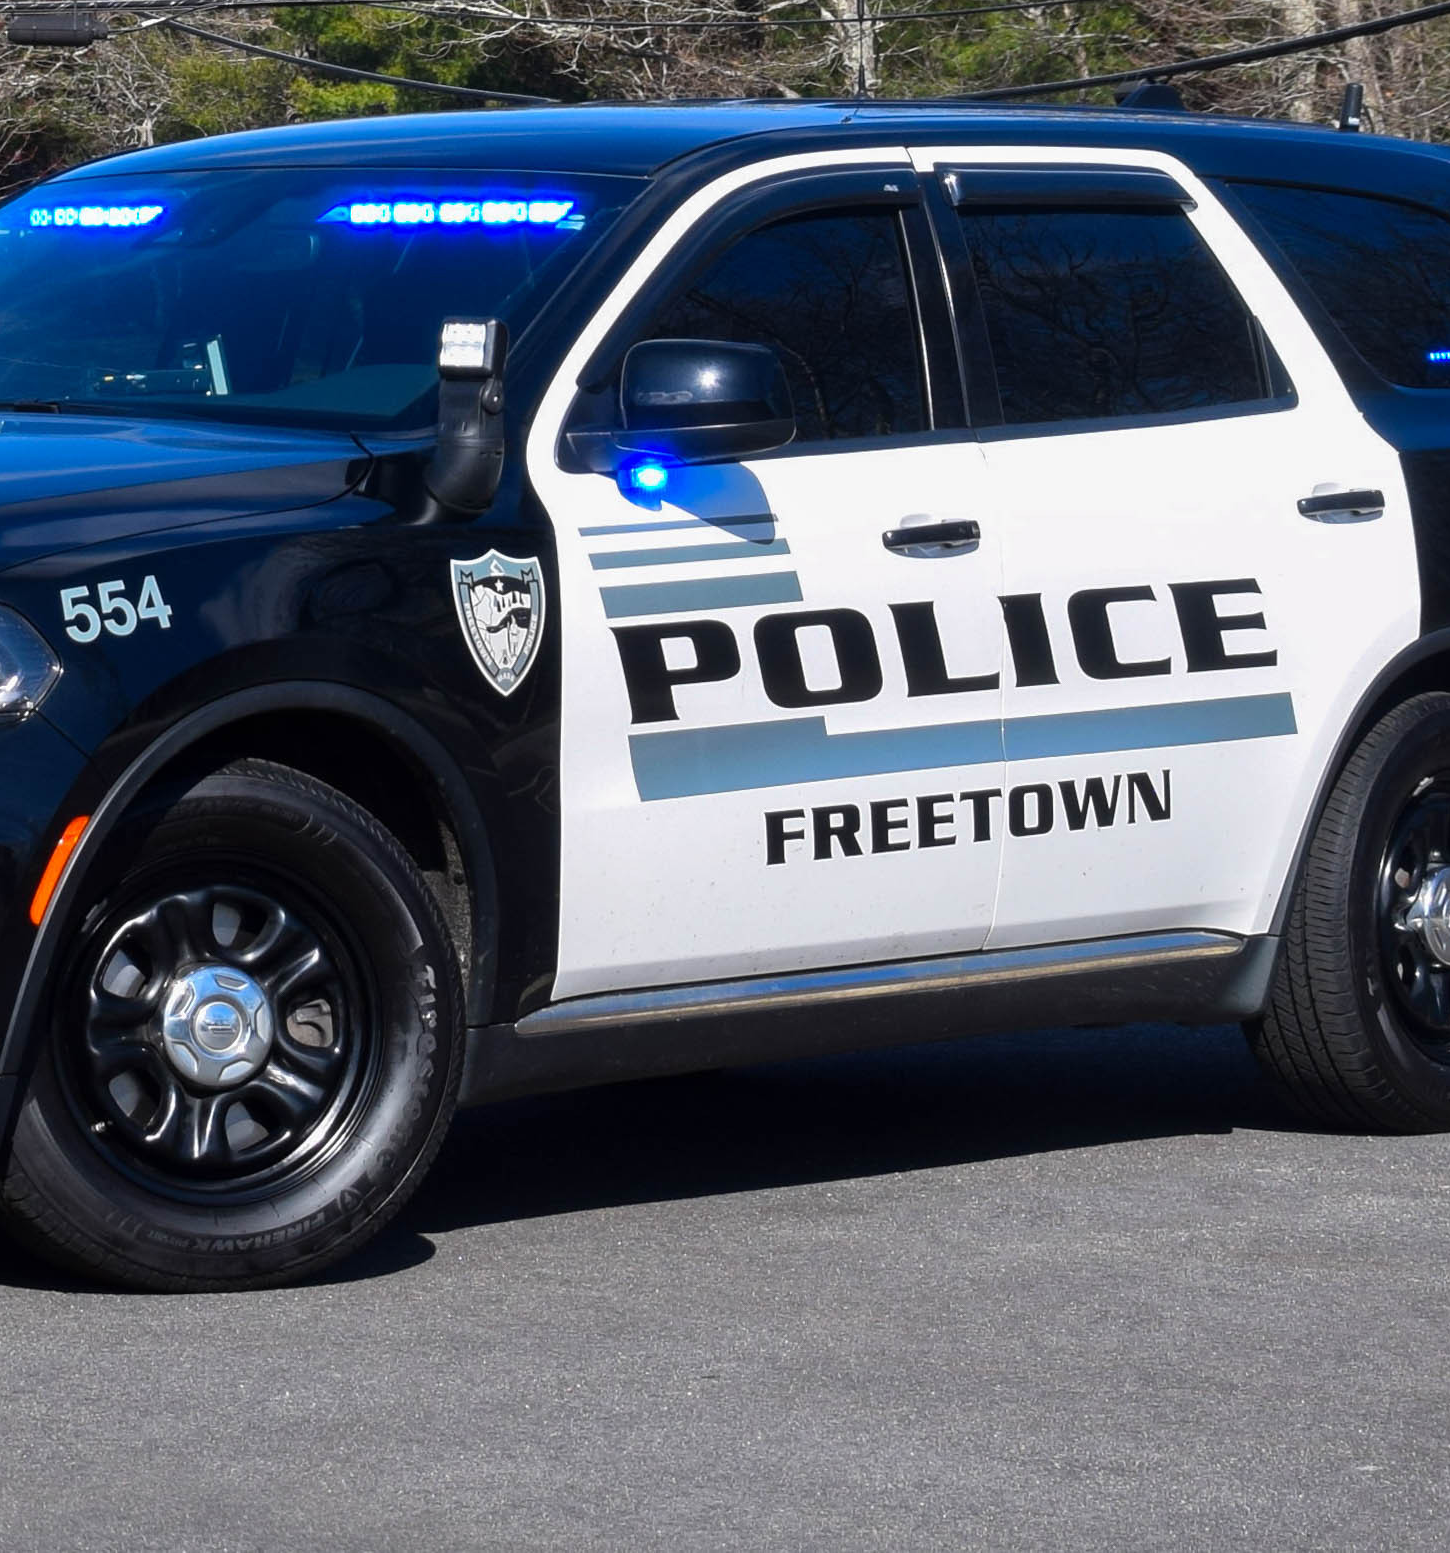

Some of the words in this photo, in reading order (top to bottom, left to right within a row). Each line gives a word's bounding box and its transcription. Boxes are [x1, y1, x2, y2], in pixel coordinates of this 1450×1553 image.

[59, 574, 173, 644] 554
[608, 577, 1279, 725] POLICE
[763, 767, 1172, 867] FREETOWN
